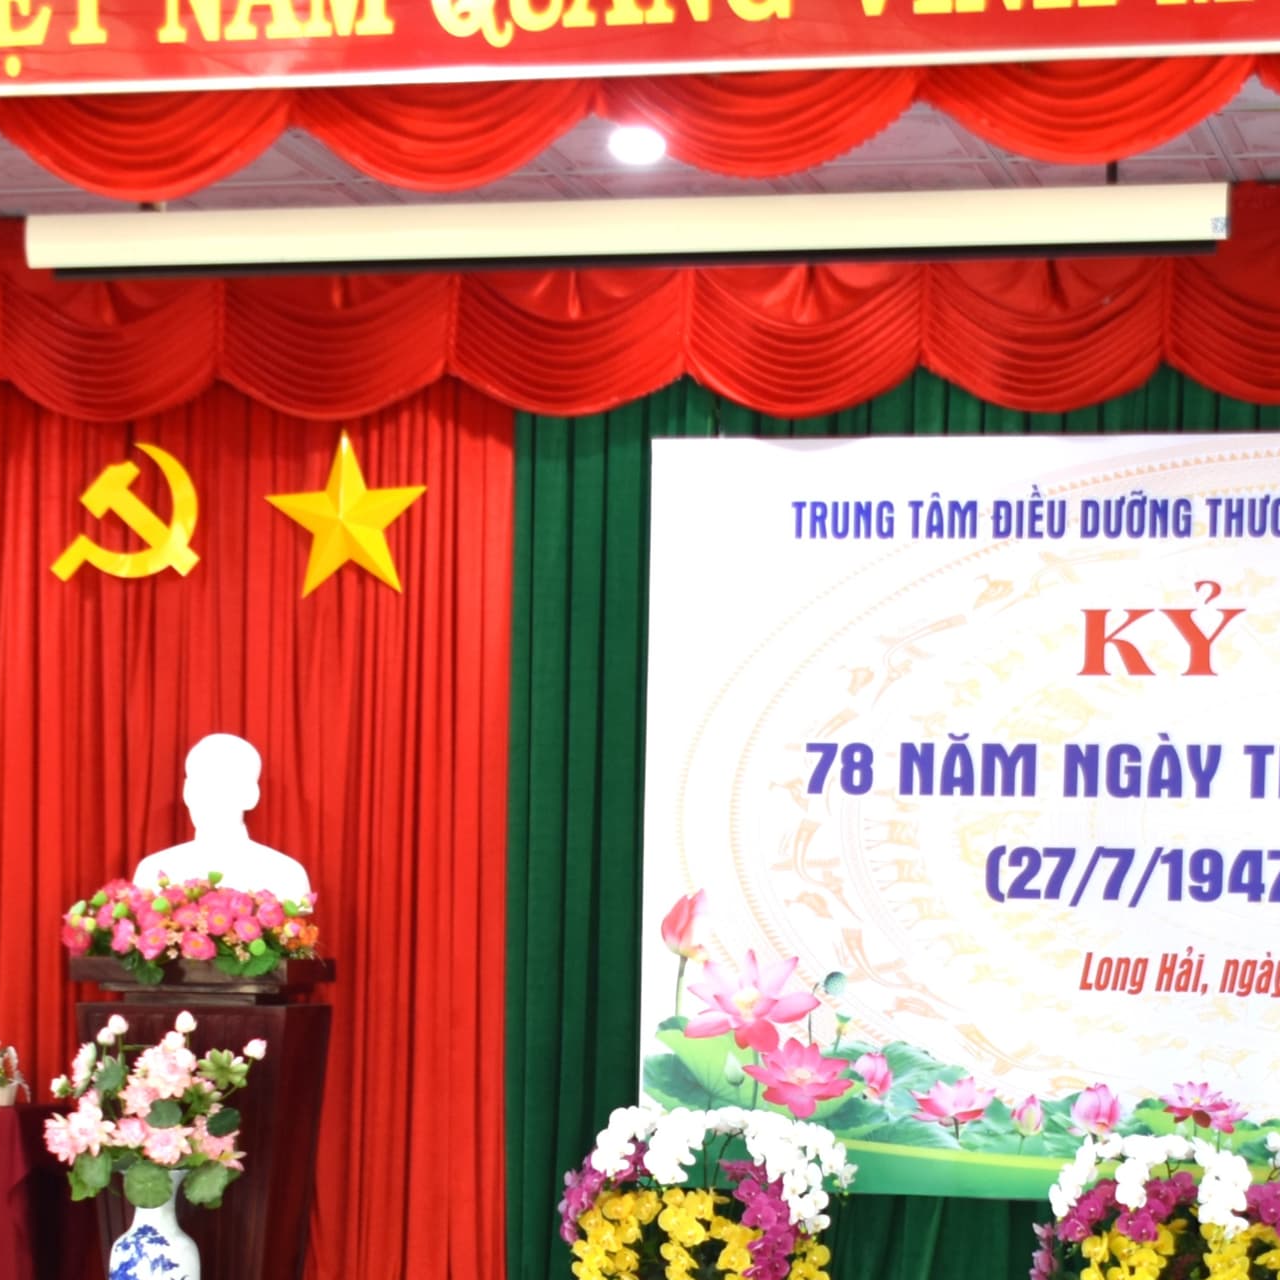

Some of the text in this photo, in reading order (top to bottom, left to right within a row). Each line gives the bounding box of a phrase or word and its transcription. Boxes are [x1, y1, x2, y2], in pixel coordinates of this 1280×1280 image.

[792, 500, 894, 539] TRUNG
[908, 491, 978, 539] TÂM
[991, 484, 1067, 539] ĐIỀU
[1080, 490, 1192, 539] DƯỠNG
[1077, 580, 1247, 676] KỶ
[805, 742, 874, 795] 78
[899, 733, 1037, 797] NĂM
[1063, 732, 1222, 798] NGÀY
[1079, 952, 1149, 995] Long
[1155, 946, 1208, 995] Hải,
